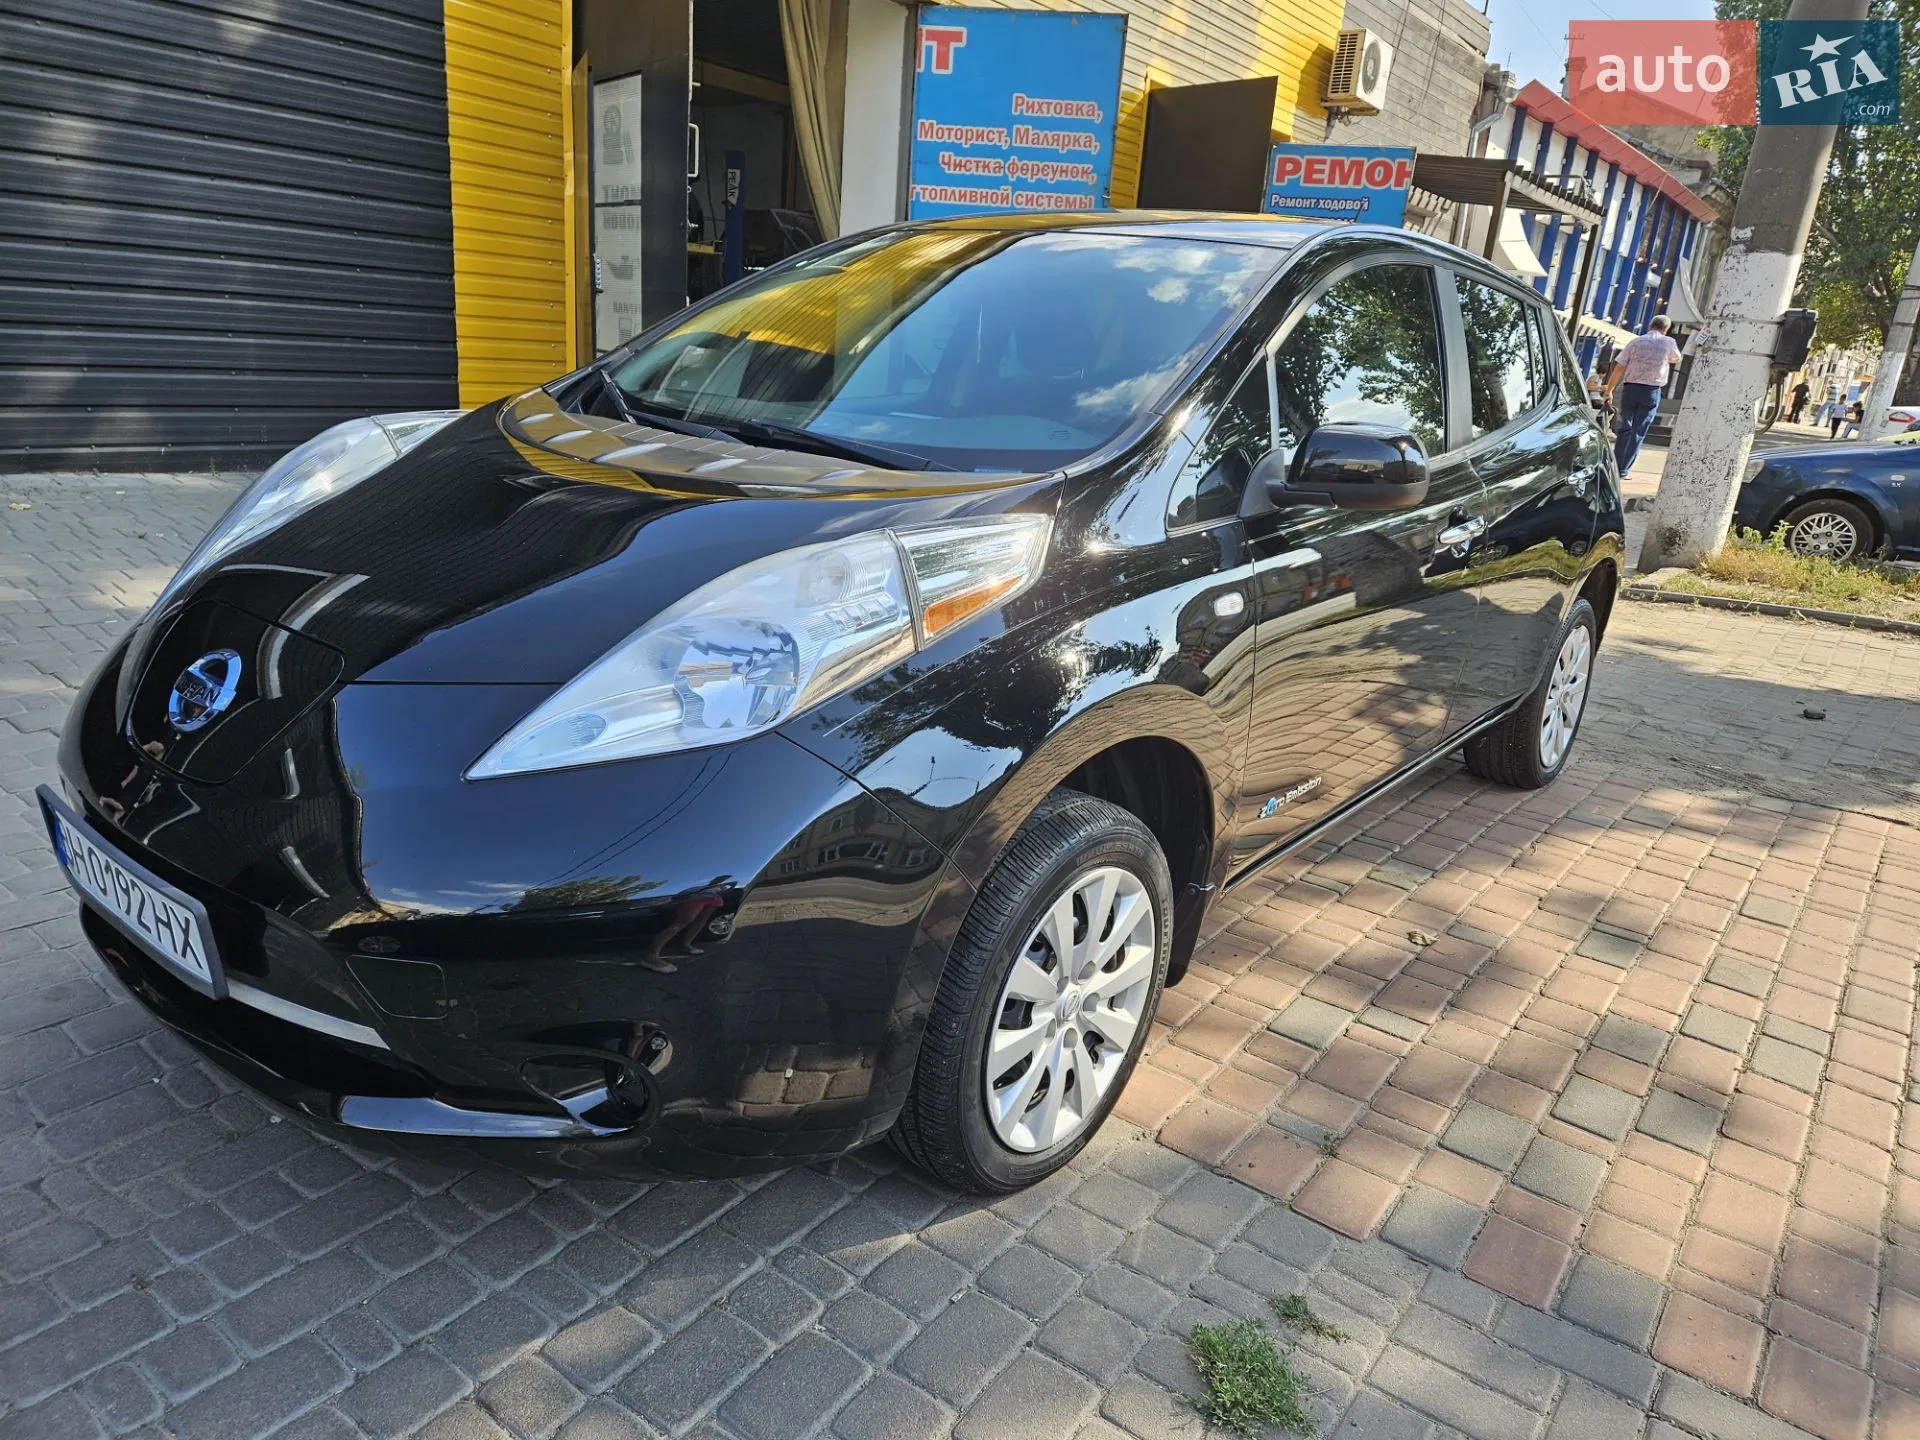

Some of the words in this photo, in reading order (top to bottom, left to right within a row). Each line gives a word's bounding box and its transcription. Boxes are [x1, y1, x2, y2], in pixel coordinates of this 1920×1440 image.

[1013, 93, 1102, 121] Рихтовка,
[918, 120, 1010, 148] Моторист,
[1012, 125, 1099, 154] Малярка,
[940, 152, 1003, 174] Чистка
[1006, 156, 1096, 184] форсунок,
[920, 184, 1010, 207] топливной
[1014, 193, 1094, 209] системы
[1271, 194, 1317, 208] Ремонт
[1318, 196, 1369, 210] ходовой
